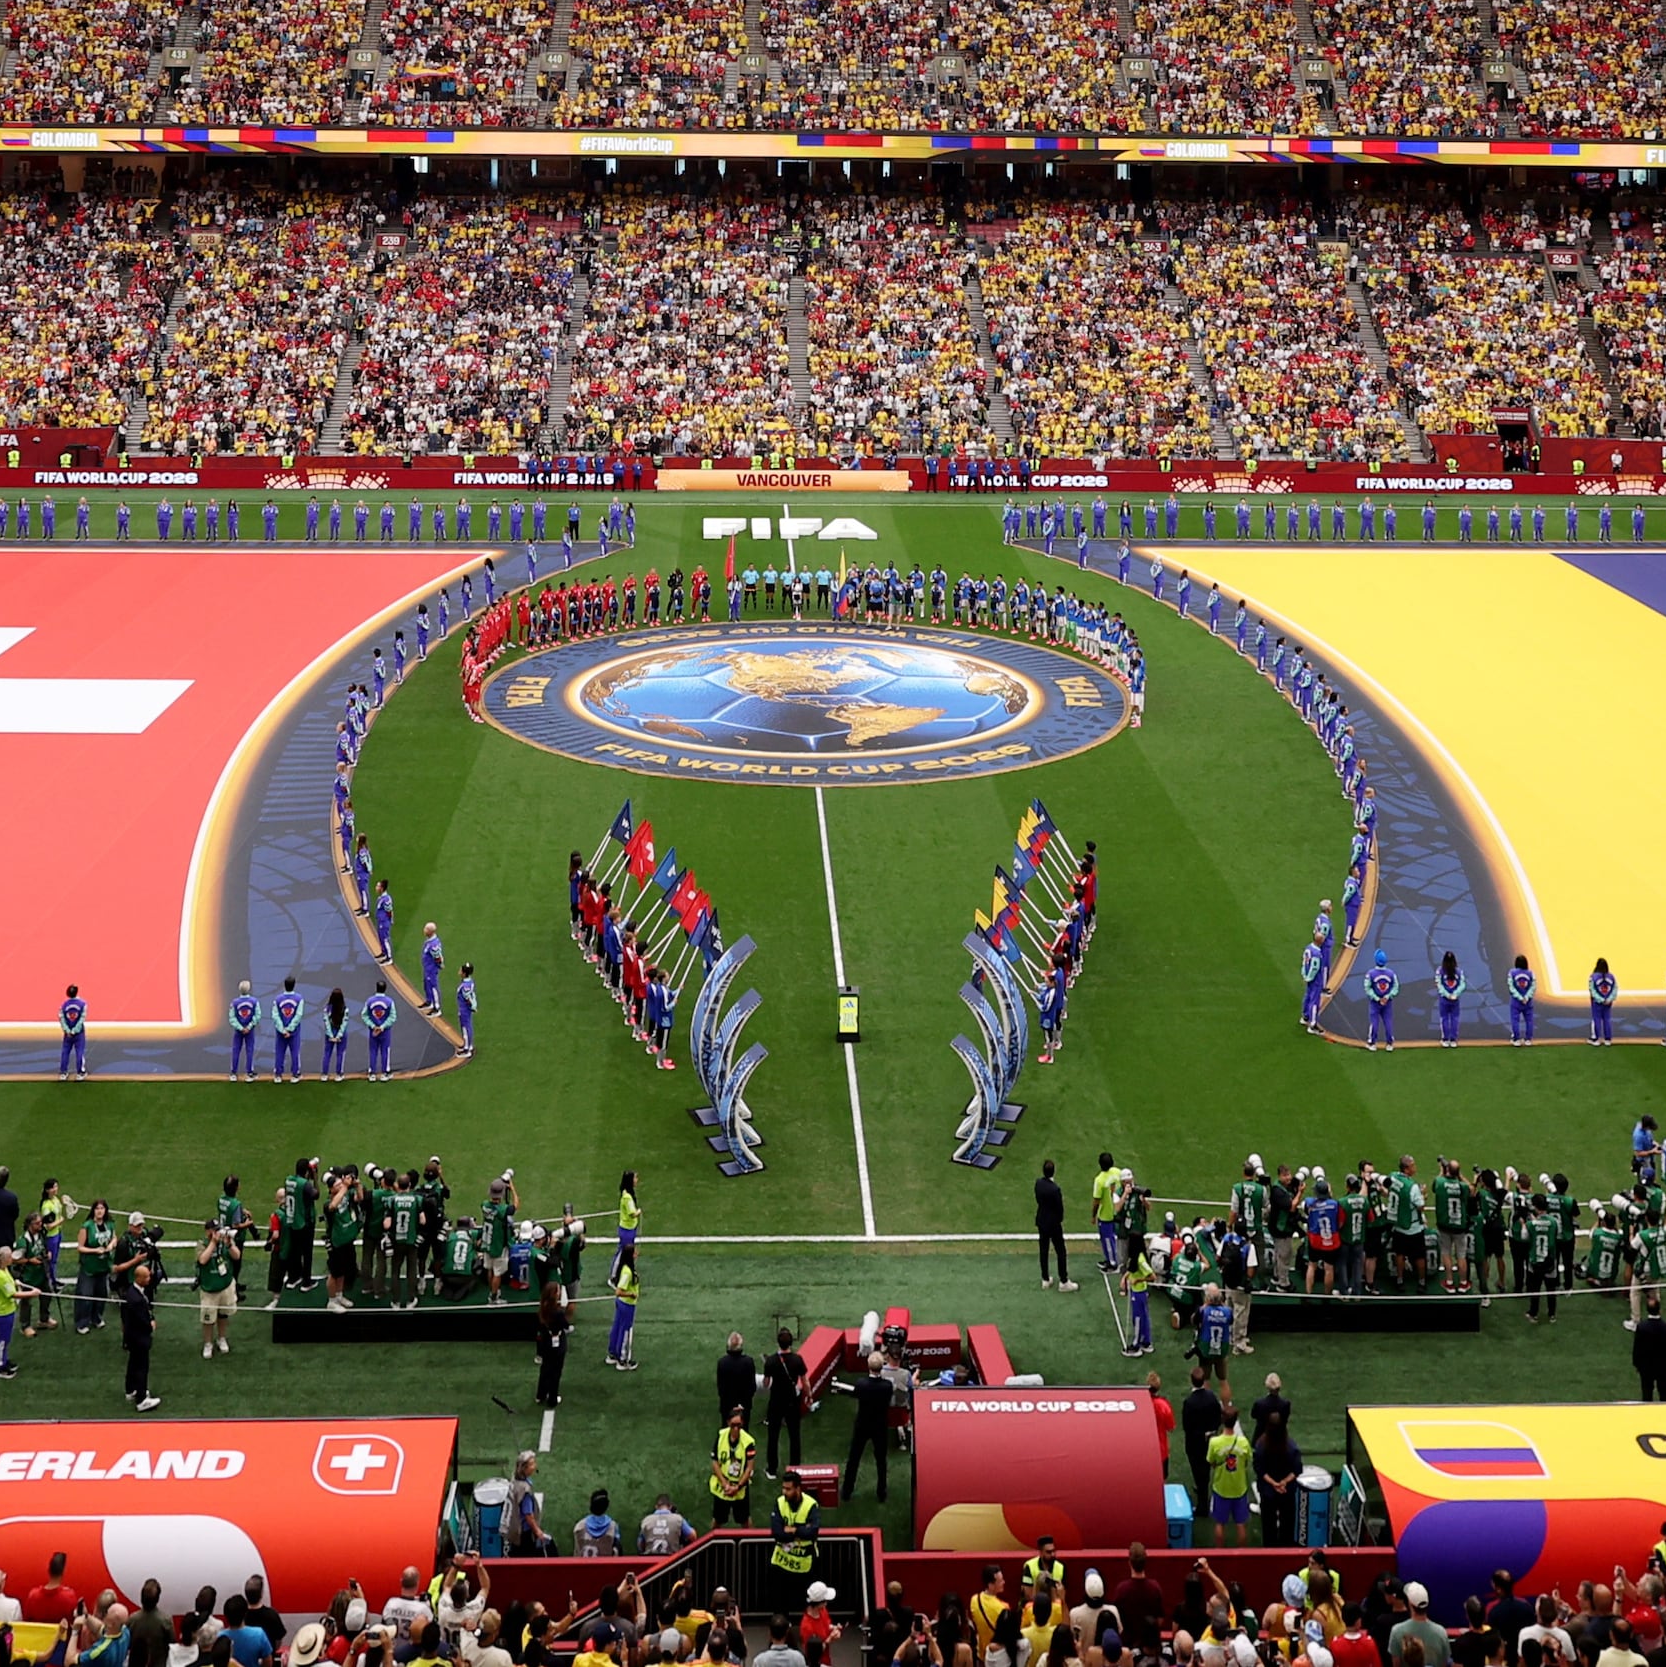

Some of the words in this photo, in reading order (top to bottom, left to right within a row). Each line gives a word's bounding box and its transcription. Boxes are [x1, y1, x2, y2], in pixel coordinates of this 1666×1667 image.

[171, 49, 187, 60] 438
[356, 52, 372, 63] 439
[547, 53, 563, 64] 440
[745, 55, 760, 66] 441
[940, 58, 955, 69] 442
[1128, 60, 1144, 72] 443
[1307, 62, 1323, 73] 444
[1488, 64, 1504, 75] 445
[31, 131, 99, 148] COLOMBIA
[580, 136, 673, 155] #FIFAWorldCup
[1166, 142, 1229, 159] COLOMBIA
[197, 234, 215, 245] 238
[381, 235, 400, 246] 239
[1552, 254, 1572, 265] 245
[34, 472, 70, 484] FIFA
[70, 472, 118, 484] WORLD
[117, 472, 148, 484] CUP
[148, 472, 199, 484] 2026
[454, 473, 487, 485] FIFA
[736, 474, 832, 487] VANCOUVER
[1031, 475, 1060, 486] CUP
[1060, 475, 1109, 487] 2026
[1356, 478, 1387, 490] FIFA
[1386, 478, 1437, 490] WORLD
[1437, 478, 1465, 490] CUP
[1465, 478, 1513, 490] 2026
[702, 517, 878, 540] FIFA
[729, 625, 789, 635] CUP
[617, 627, 722, 648] 2026
[506, 675, 552, 708] FIFA
[1054, 675, 1103, 707] FIFA
[594, 743, 670, 763] FIFA
[677, 758, 818, 776] WORLD
[827, 762, 904, 776] CUP
[910, 742, 1032, 770] 2026
[923, 1347, 952, 1356] 2026
[931, 1400, 970, 1412] FIFA
[970, 1400, 1035, 1412] WORLD
[1036, 1400, 1072, 1412] CUP
[1073, 1400, 1137, 1413] 2026
